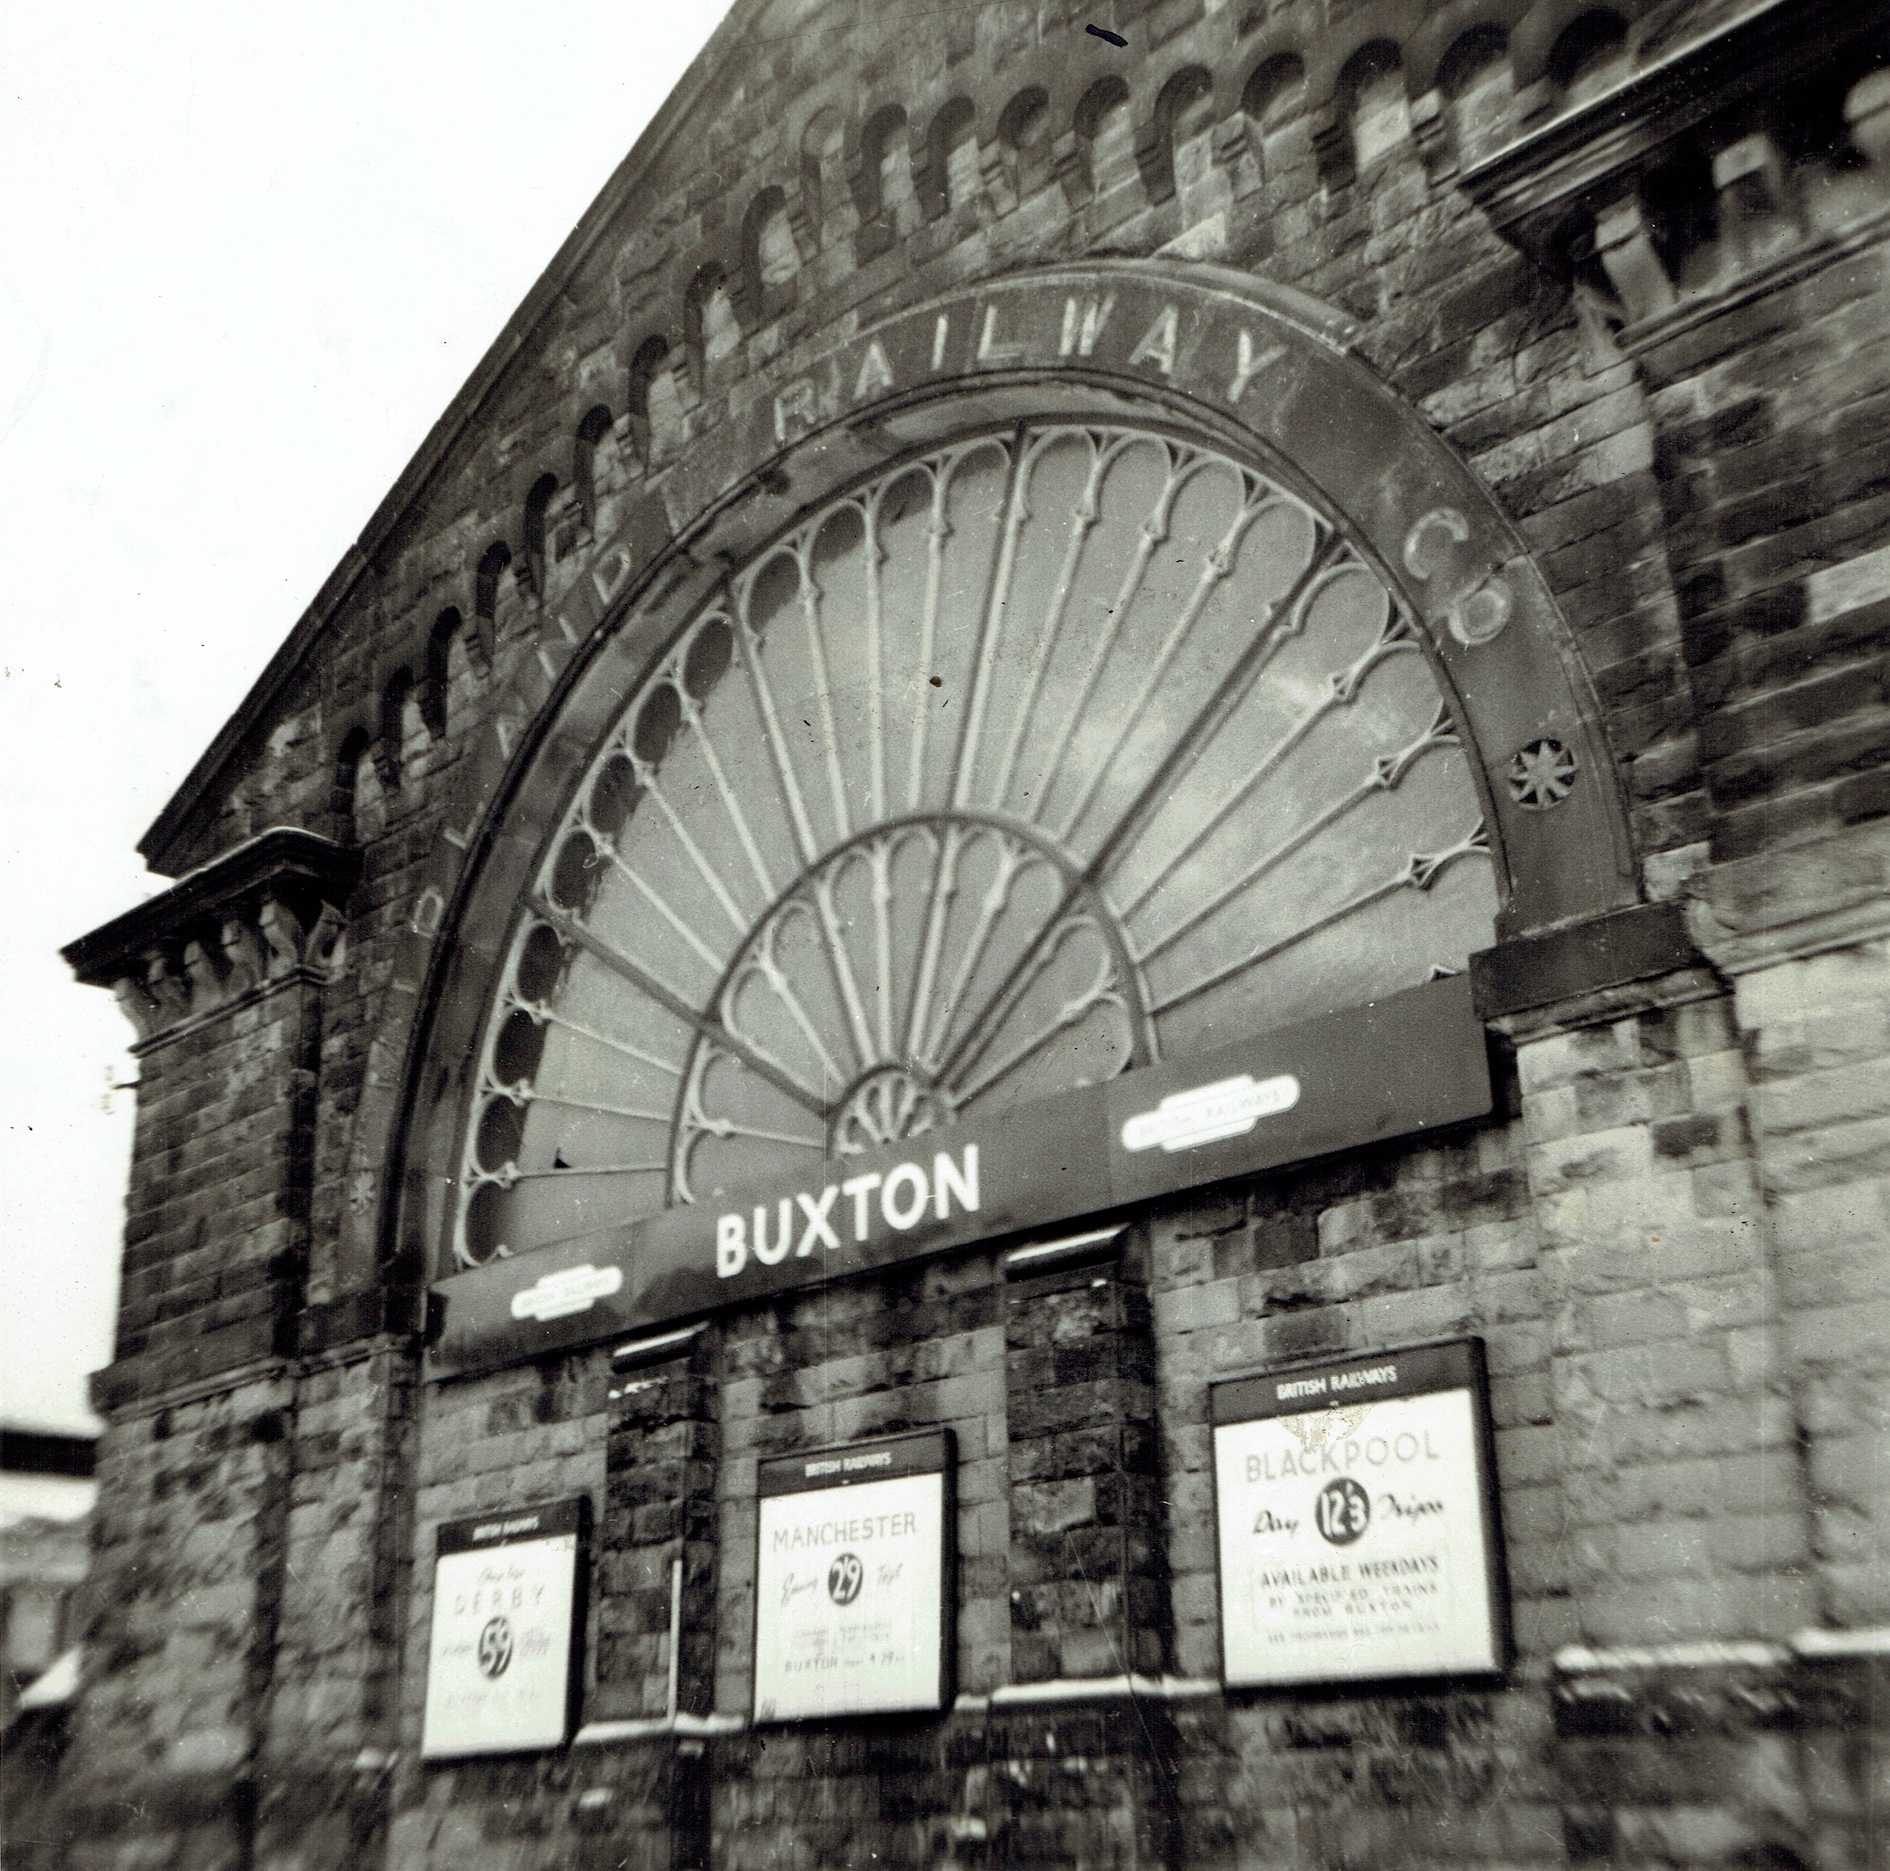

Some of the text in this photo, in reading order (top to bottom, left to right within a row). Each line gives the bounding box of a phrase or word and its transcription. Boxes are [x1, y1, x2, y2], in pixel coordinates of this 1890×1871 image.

[772, 293, 1288, 445] RAILWAY
[716, 1144, 982, 1279] BUXTON
[1276, 1365, 1397, 1400] BRITISH RAILWAYS
[1246, 1430, 1440, 1483] BLACKPOOL
[772, 1511, 917, 1552] MANCHESTER
[1261, 1555, 1439, 1588] AVAILABLE WEEKDAYS
[454, 1584, 546, 1615] DERBY
